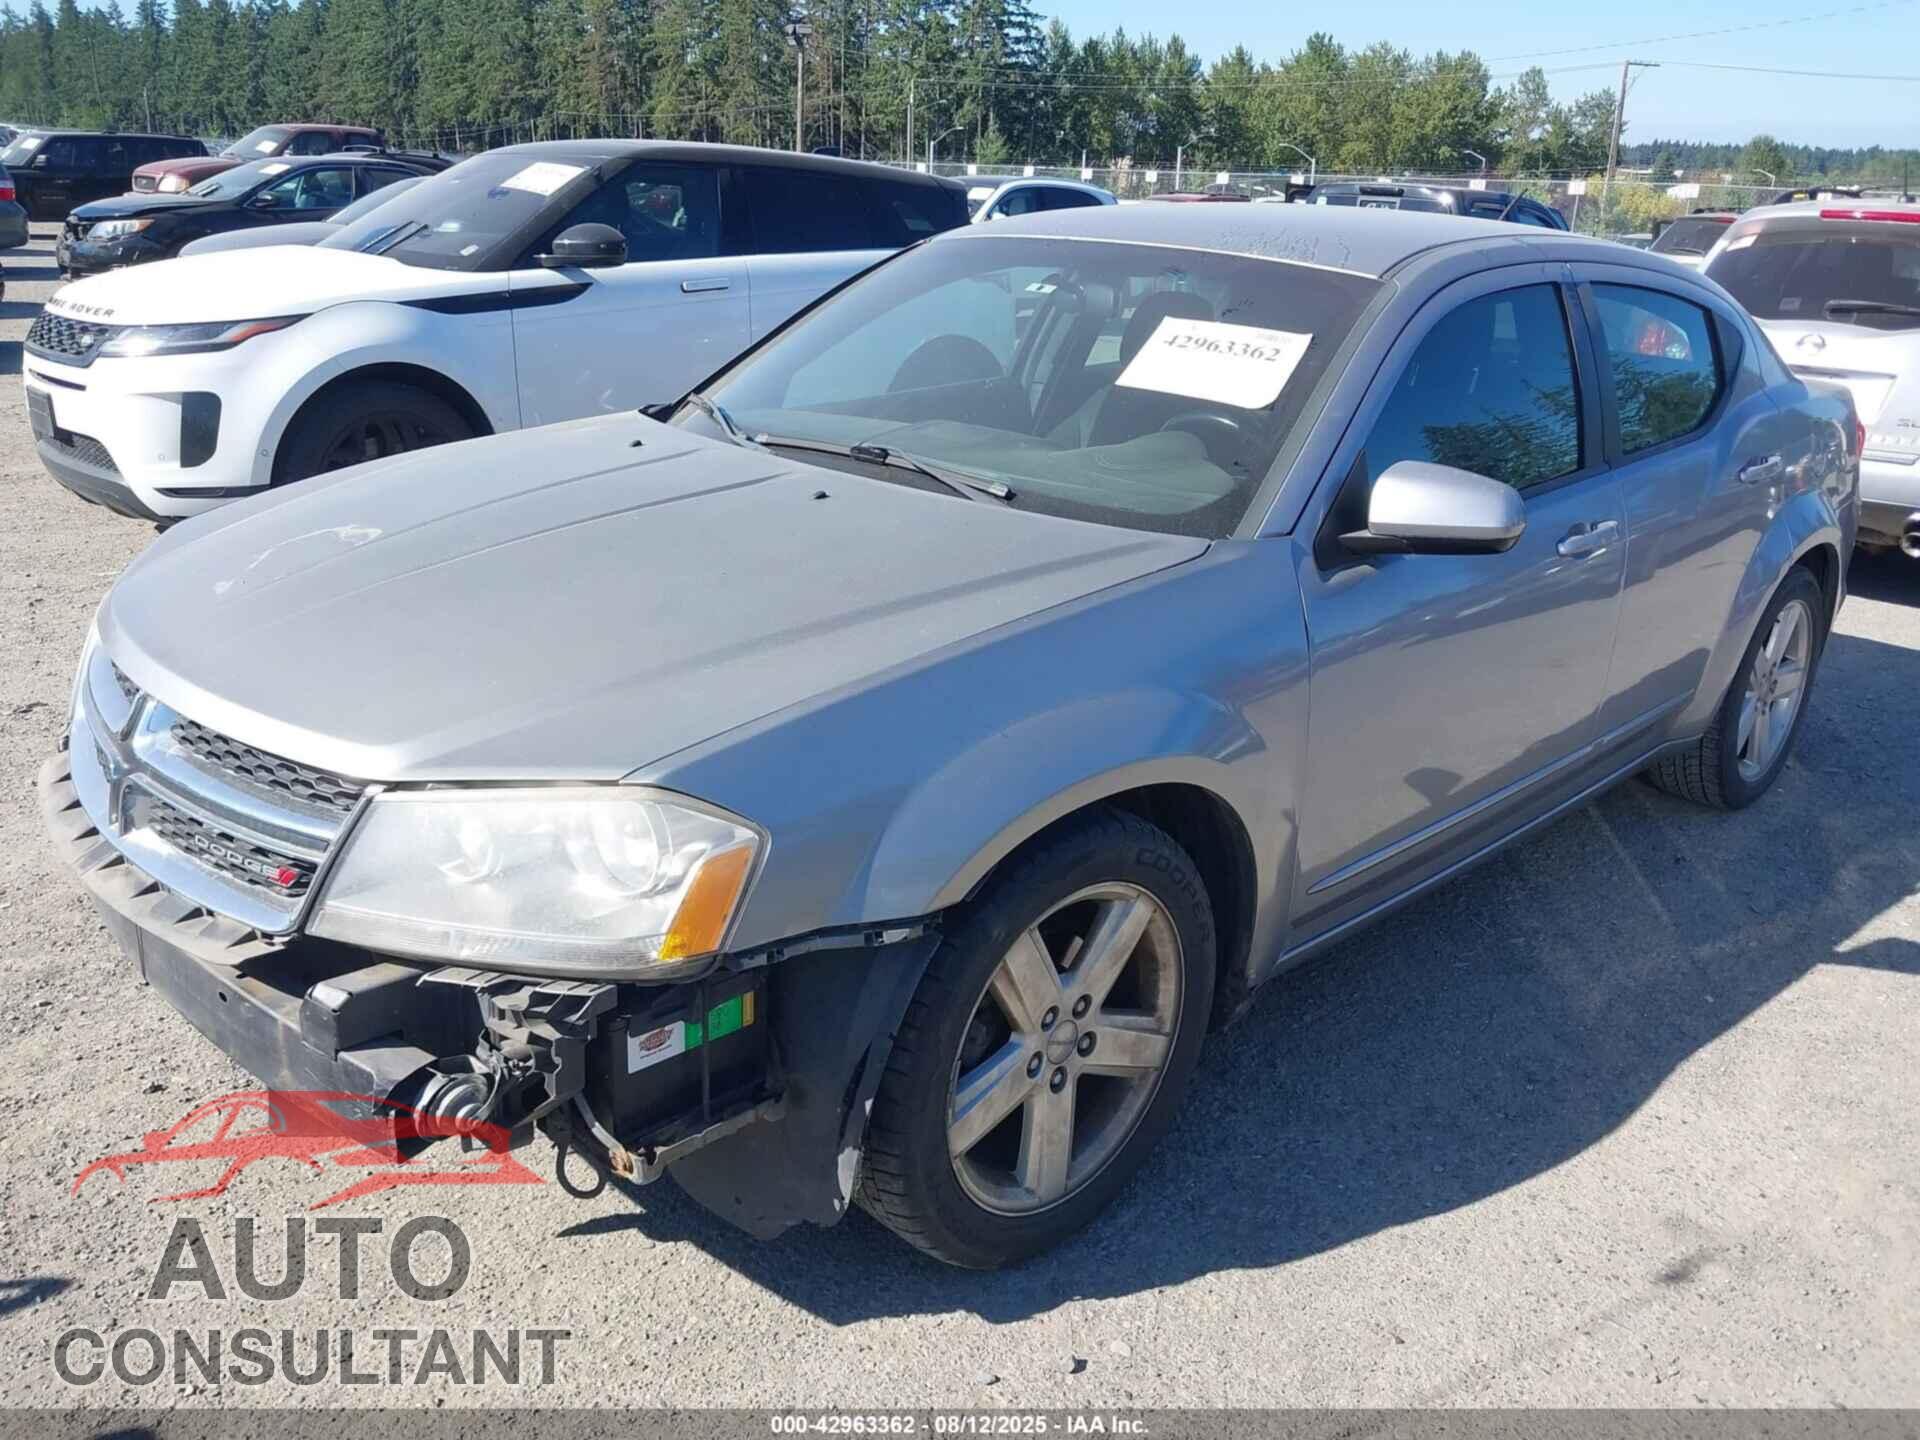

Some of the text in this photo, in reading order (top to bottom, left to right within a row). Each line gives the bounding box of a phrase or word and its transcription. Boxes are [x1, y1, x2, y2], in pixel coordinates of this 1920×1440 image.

[70, 303, 115, 317] ROVER
[1163, 333, 1281, 362] 42963362
[195, 834, 280, 880] DODGE
